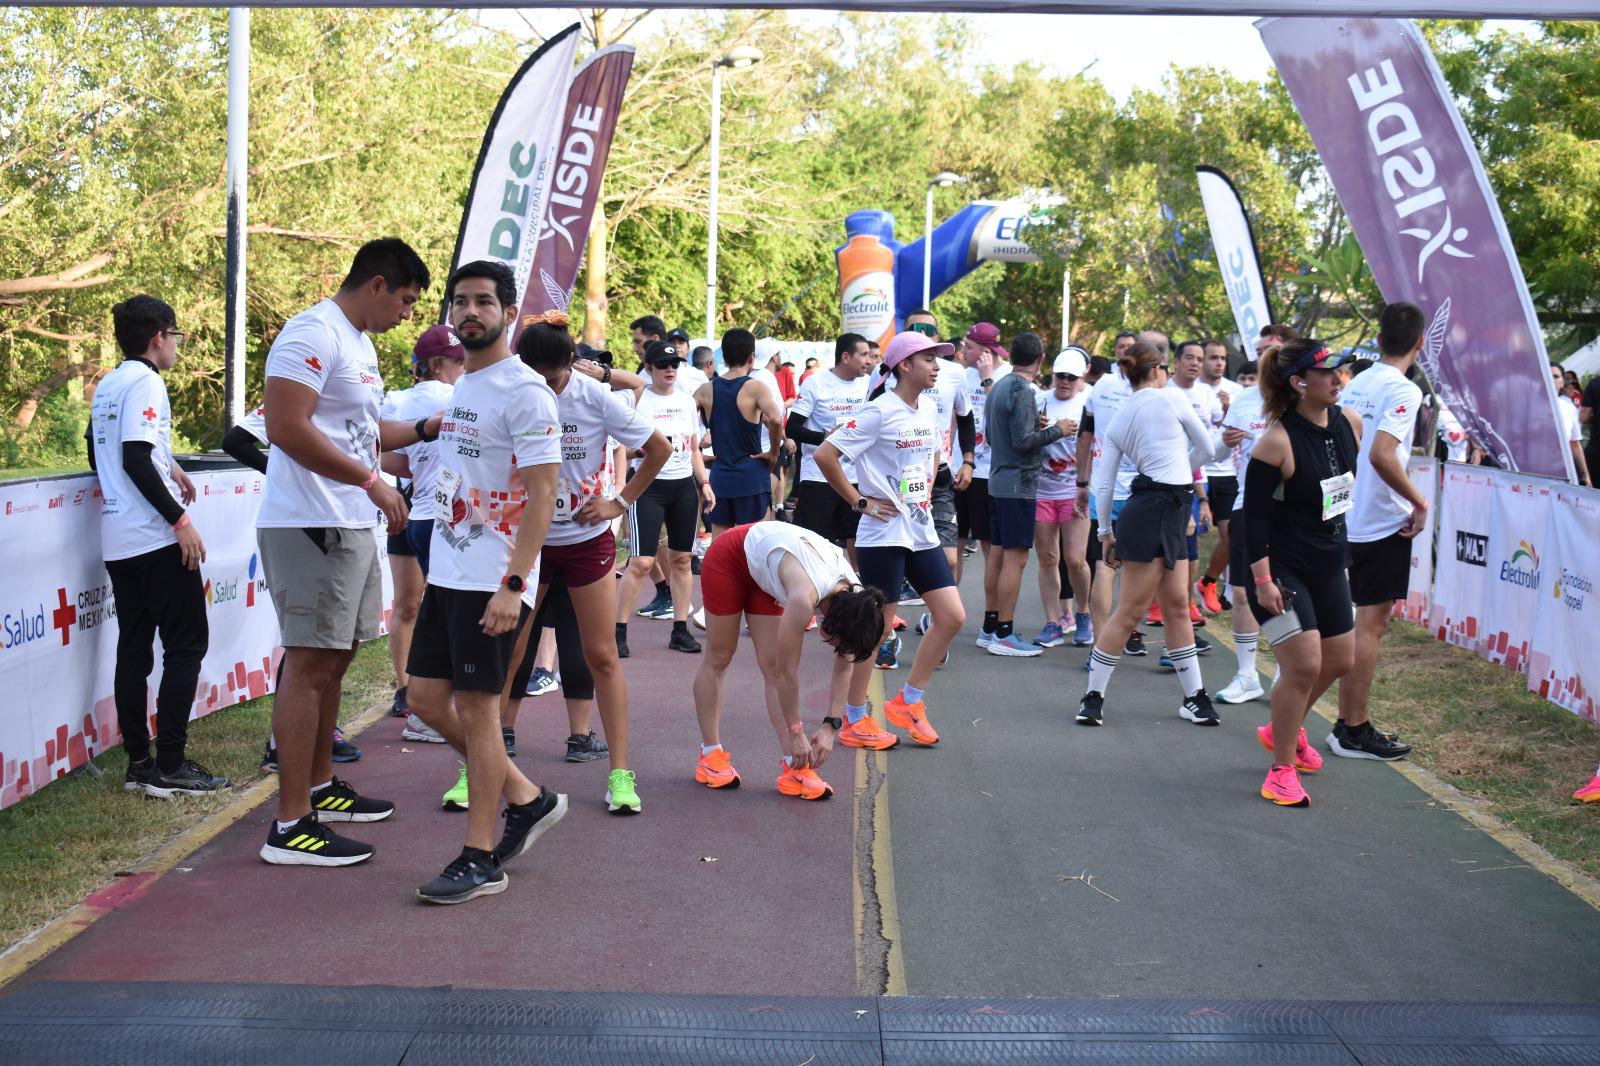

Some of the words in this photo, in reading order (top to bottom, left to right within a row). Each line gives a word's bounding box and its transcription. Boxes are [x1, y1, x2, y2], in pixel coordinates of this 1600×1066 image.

[551, 103, 603, 208] ISDE
[843, 301, 889, 314] Electrolit
[451, 406, 478, 422] México
[457, 422, 480, 438] Vidas
[457, 445, 480, 458] 2023
[565, 452, 587, 461] 2023
[908, 481, 925, 493] 658
[1331, 490, 1350, 505] 286
[78, 587, 101, 610] CRUZ
[213, 577, 239, 604] Salud
[4, 603, 45, 649] Salud
